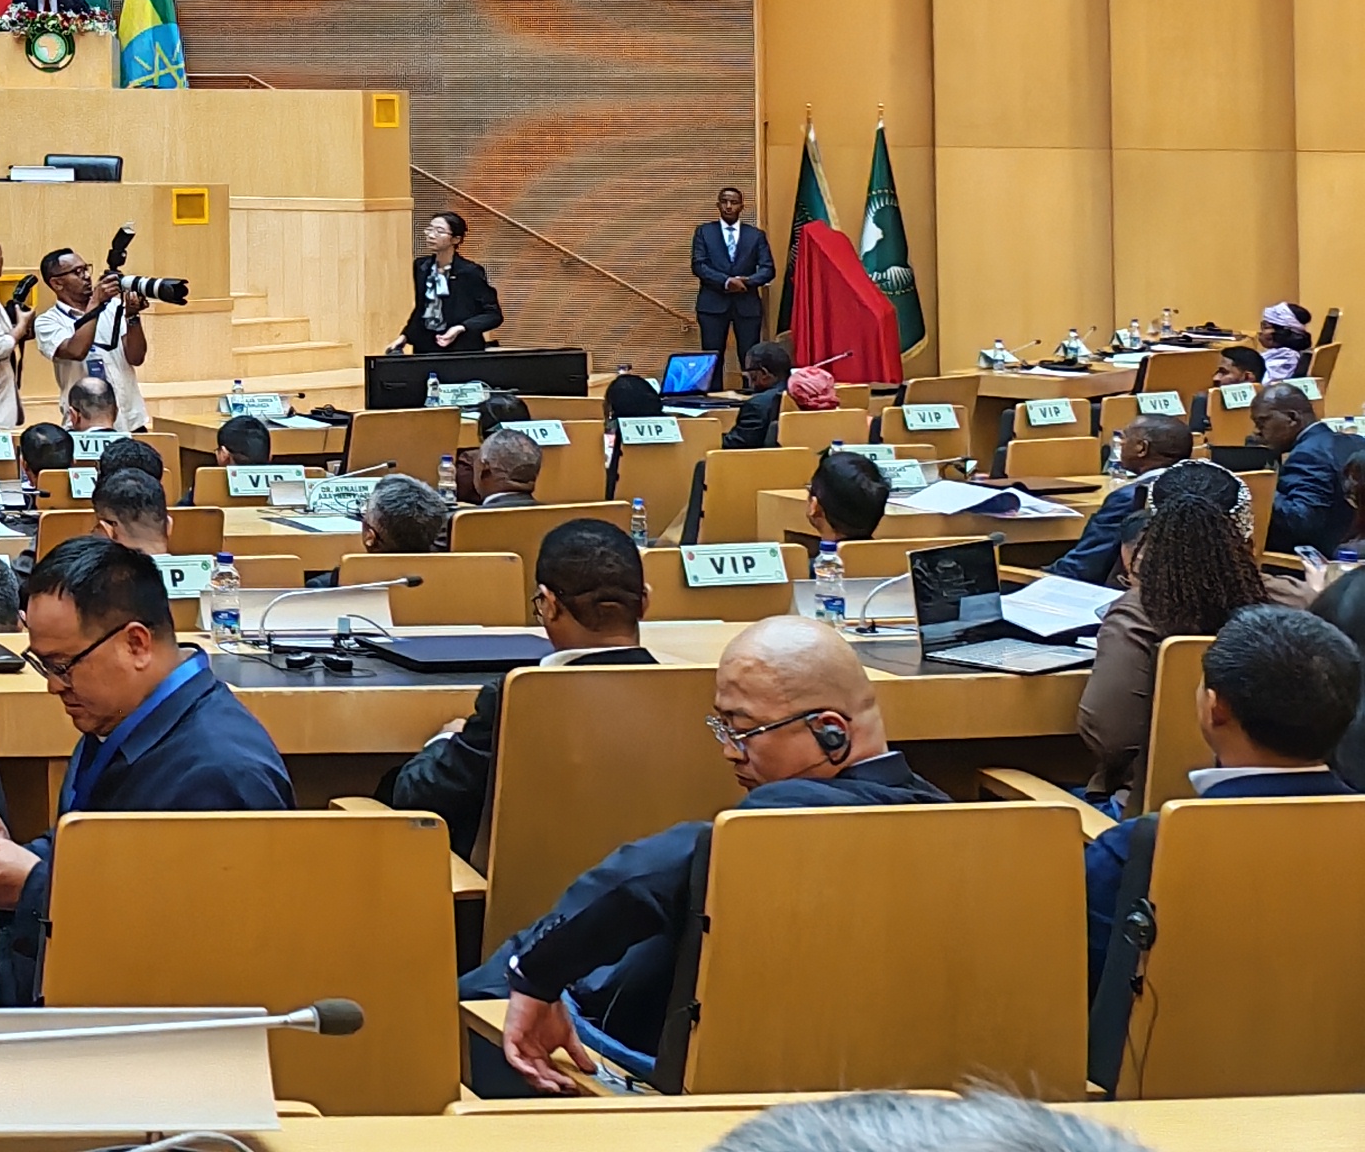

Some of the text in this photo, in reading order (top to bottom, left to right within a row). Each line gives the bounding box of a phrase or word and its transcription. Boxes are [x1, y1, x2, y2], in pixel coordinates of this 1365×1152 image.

[1233, 391, 1248, 401] VIP
[1150, 399, 1170, 410] VIP
[918, 412, 942, 423] VIP
[1039, 407, 1062, 418] VIP
[636, 424, 664, 437] VIP
[711, 557, 756, 574] VIP
